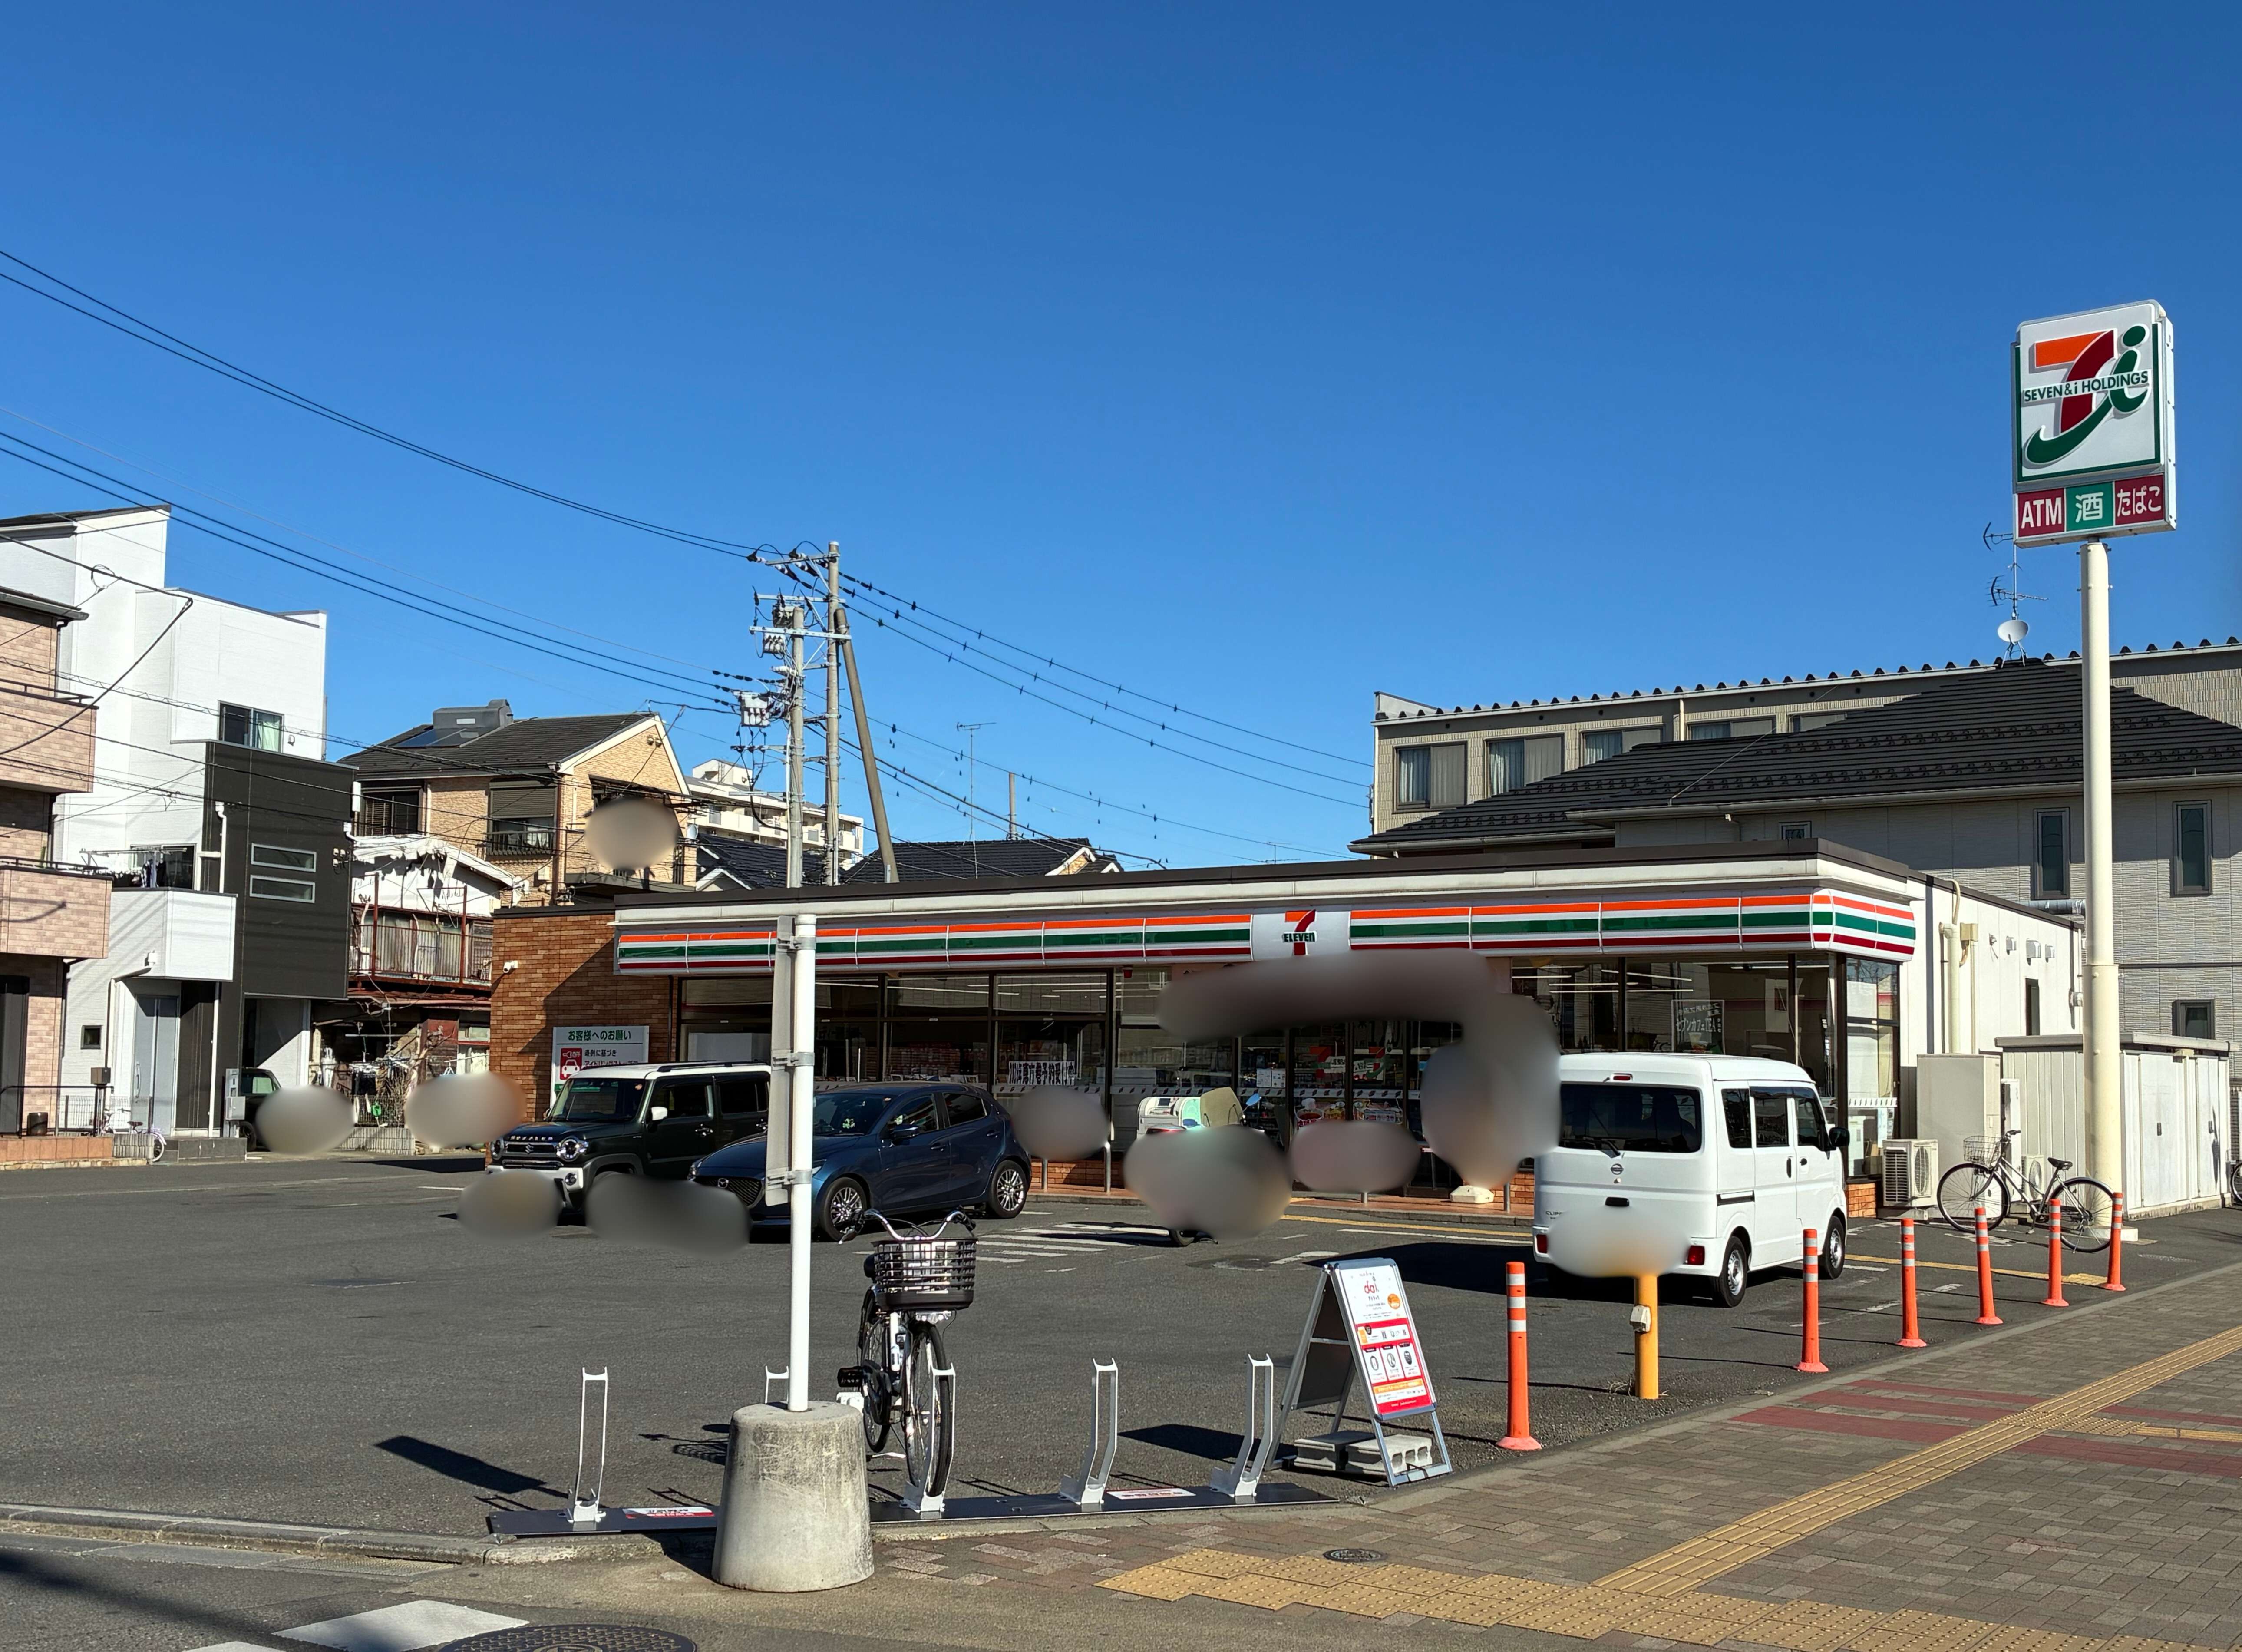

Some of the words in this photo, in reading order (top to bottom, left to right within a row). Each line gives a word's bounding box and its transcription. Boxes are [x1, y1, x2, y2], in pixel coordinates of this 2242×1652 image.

[2082, 370, 2148, 393] HOLDINGS
[2021, 497, 2062, 529] ATM
[2075, 492, 2104, 523] 酒
[2117, 485, 2162, 517] たばこ
[568, 1030, 631, 1041] お客様へのお願い
